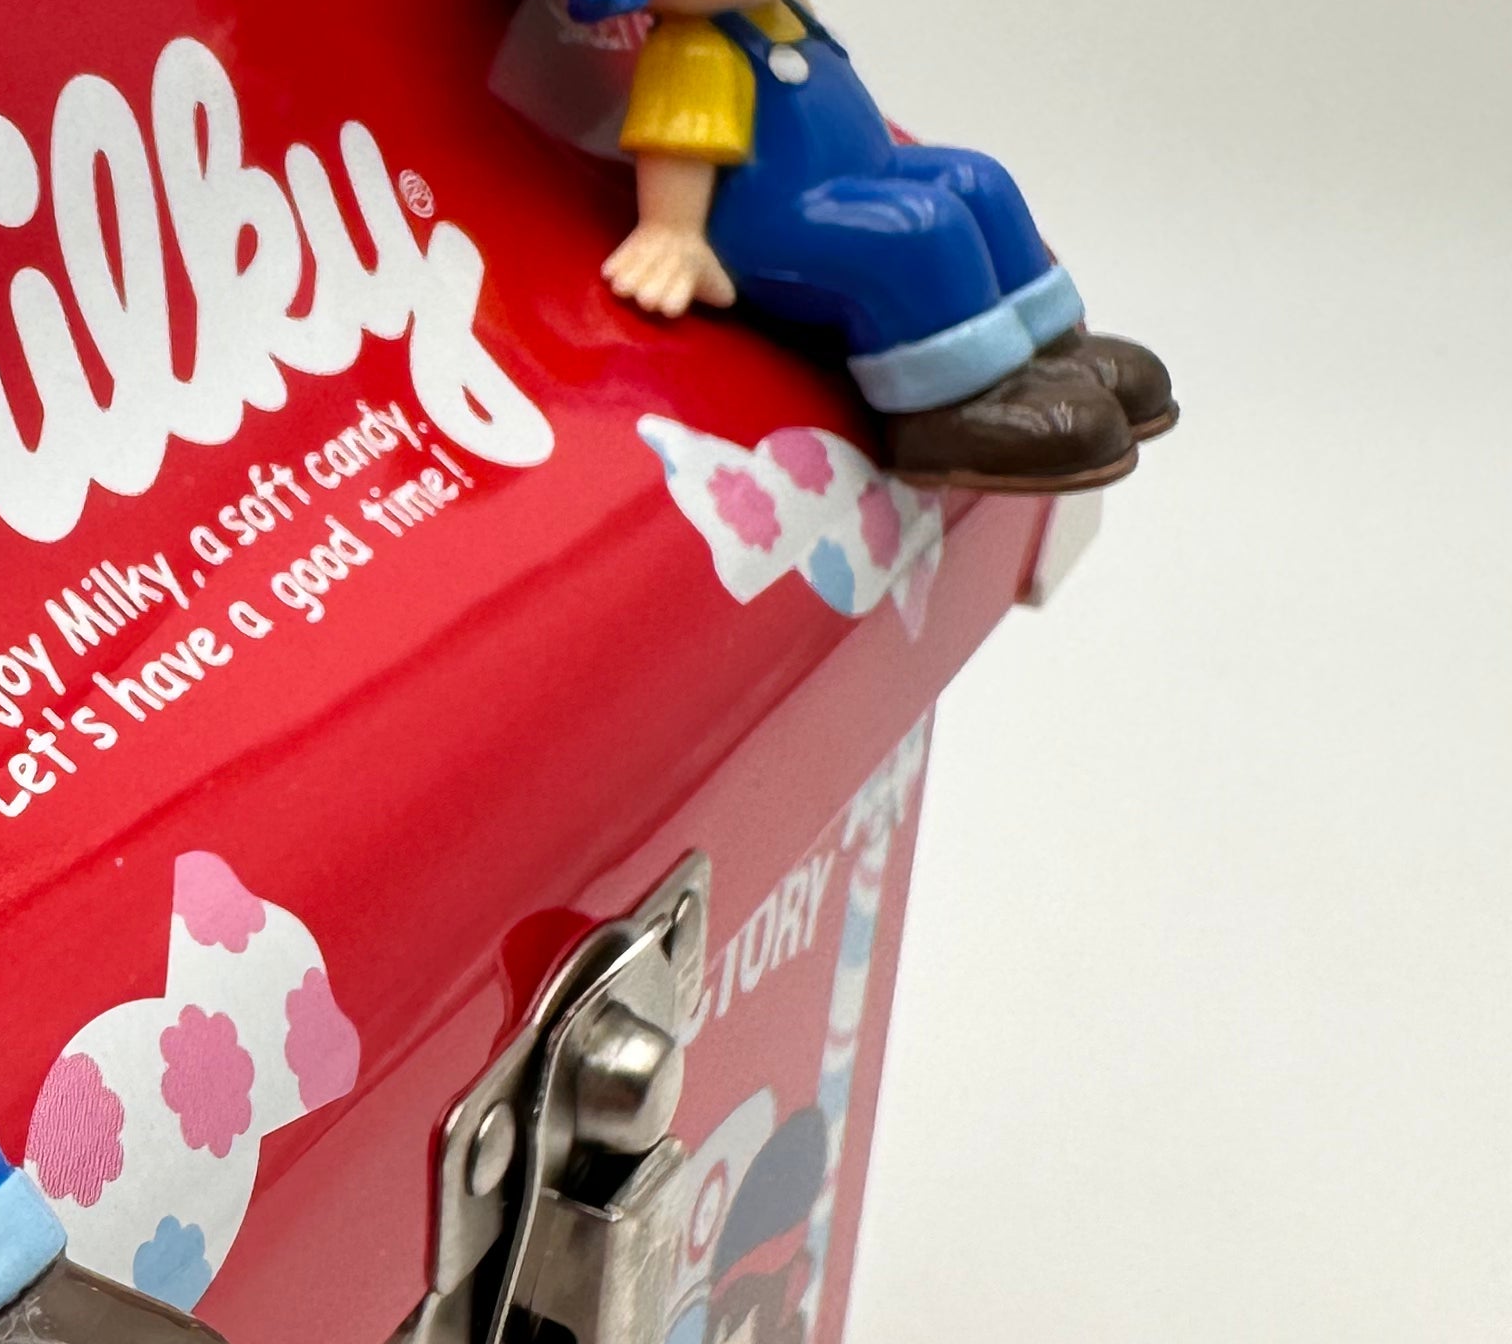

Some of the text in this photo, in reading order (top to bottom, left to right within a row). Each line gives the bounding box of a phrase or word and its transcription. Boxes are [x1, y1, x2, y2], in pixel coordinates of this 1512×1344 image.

[94, 625, 234, 723] have
[231, 601, 273, 639] a
[271, 515, 373, 624] good
[360, 444, 474, 537] time!
[191, 526, 233, 564] a
[218, 464, 310, 546] soft
[303, 399, 428, 490] candy.
